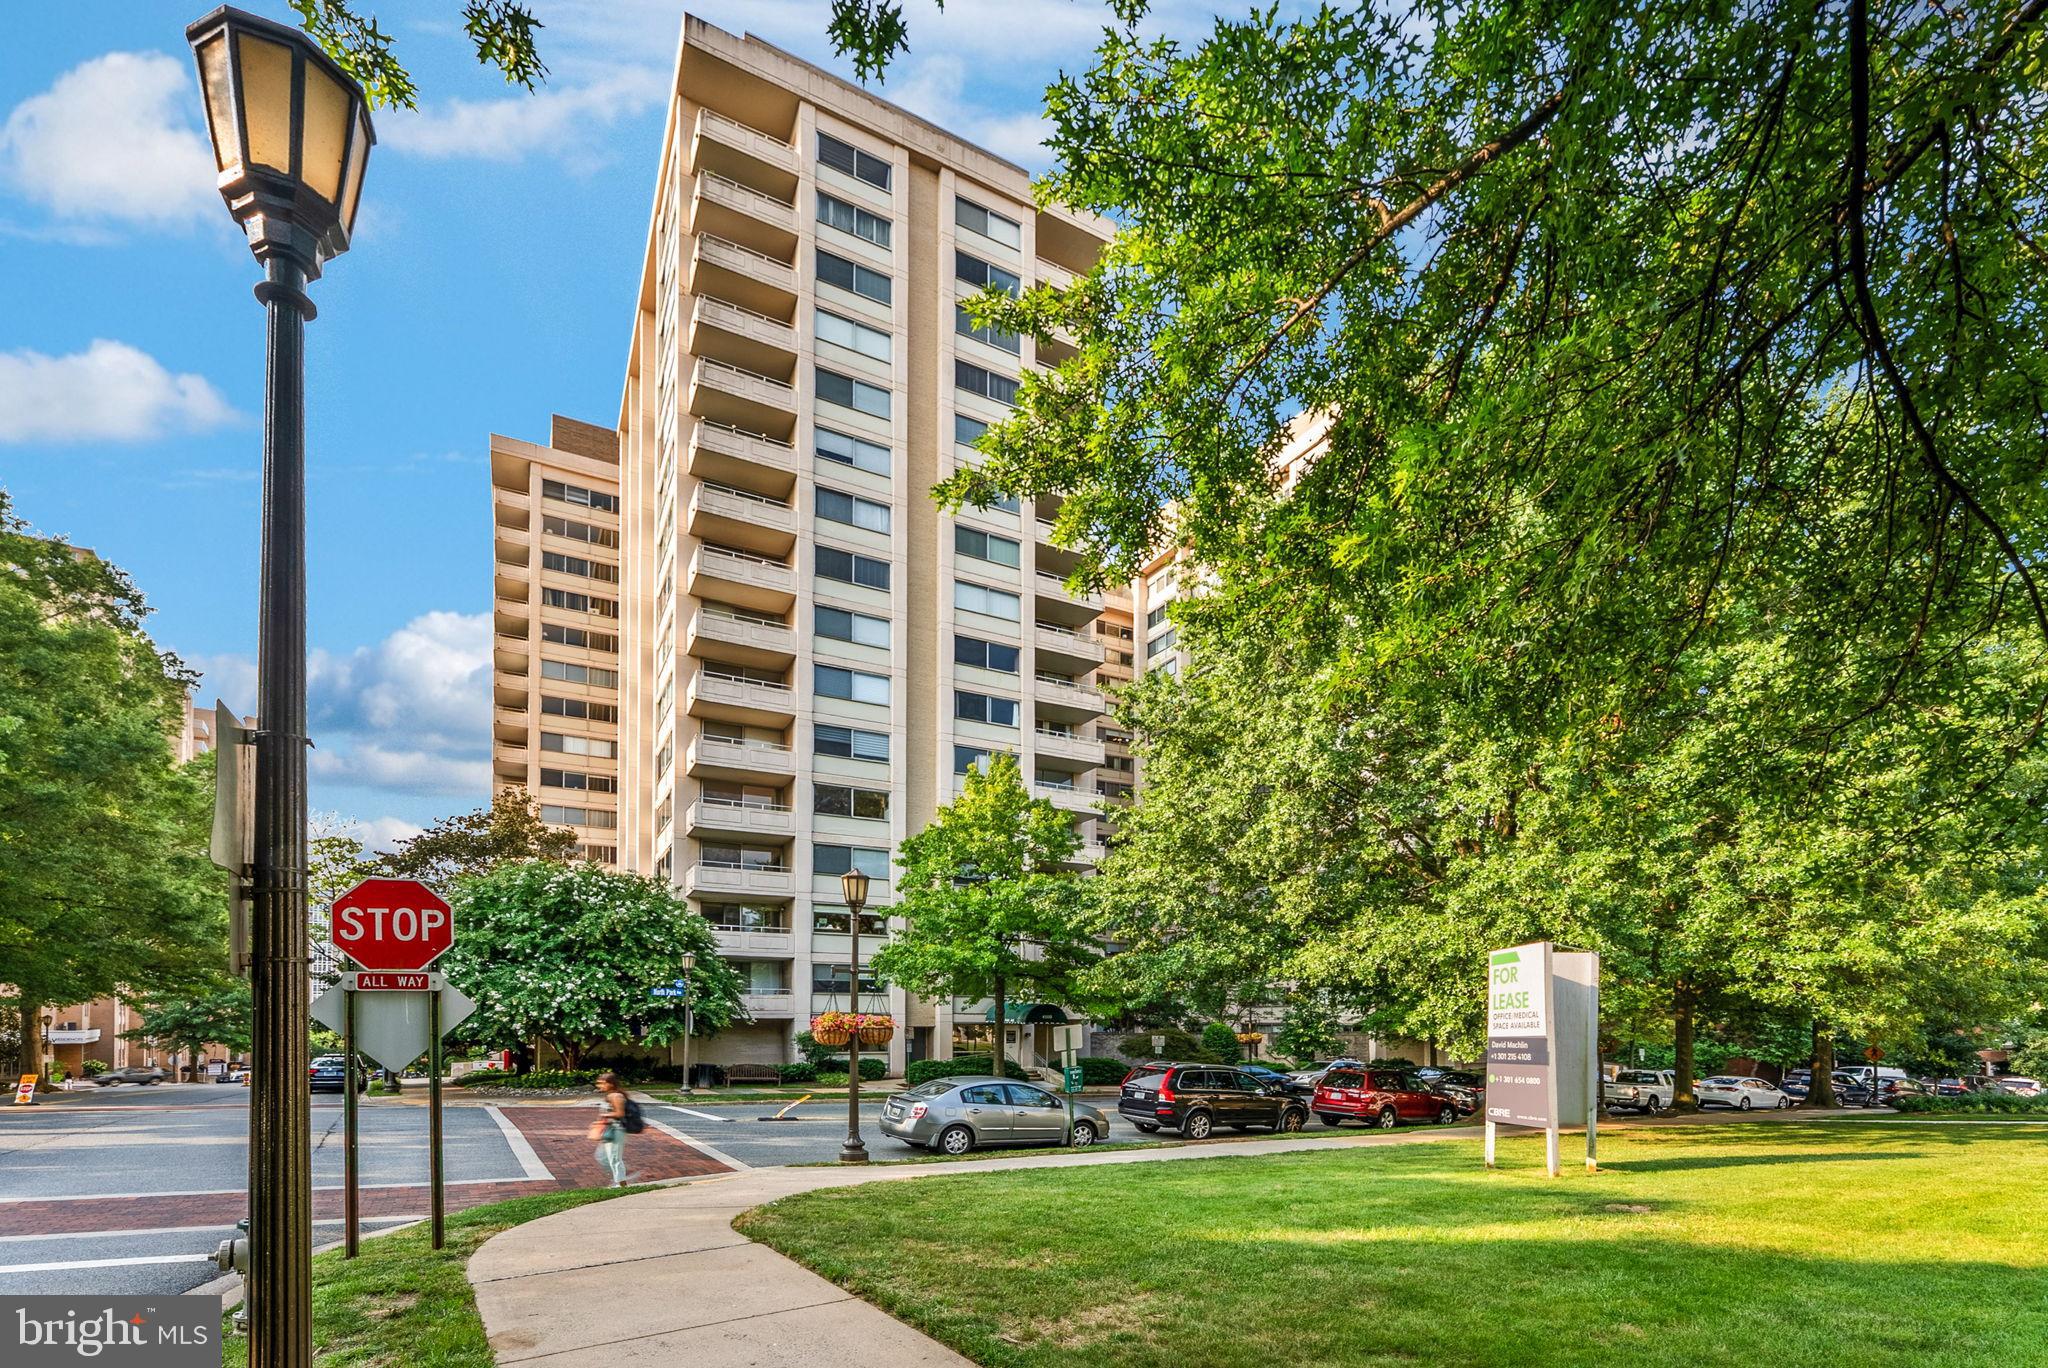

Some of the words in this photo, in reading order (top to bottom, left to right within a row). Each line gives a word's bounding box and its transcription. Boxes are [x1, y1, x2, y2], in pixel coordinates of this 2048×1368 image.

[340, 907, 444, 941] STOP
[1493, 966, 1518, 985] FOR
[363, 976, 388, 987] ALL
[398, 976, 423, 987] WAY
[666, 988, 677, 996] Park
[1493, 991, 1529, 1010] LEASE
[1493, 1022, 1509, 1030] SPACE
[1510, 1021, 1540, 1029] AVAILABLE
[1488, 1107, 1511, 1117] CBRE
